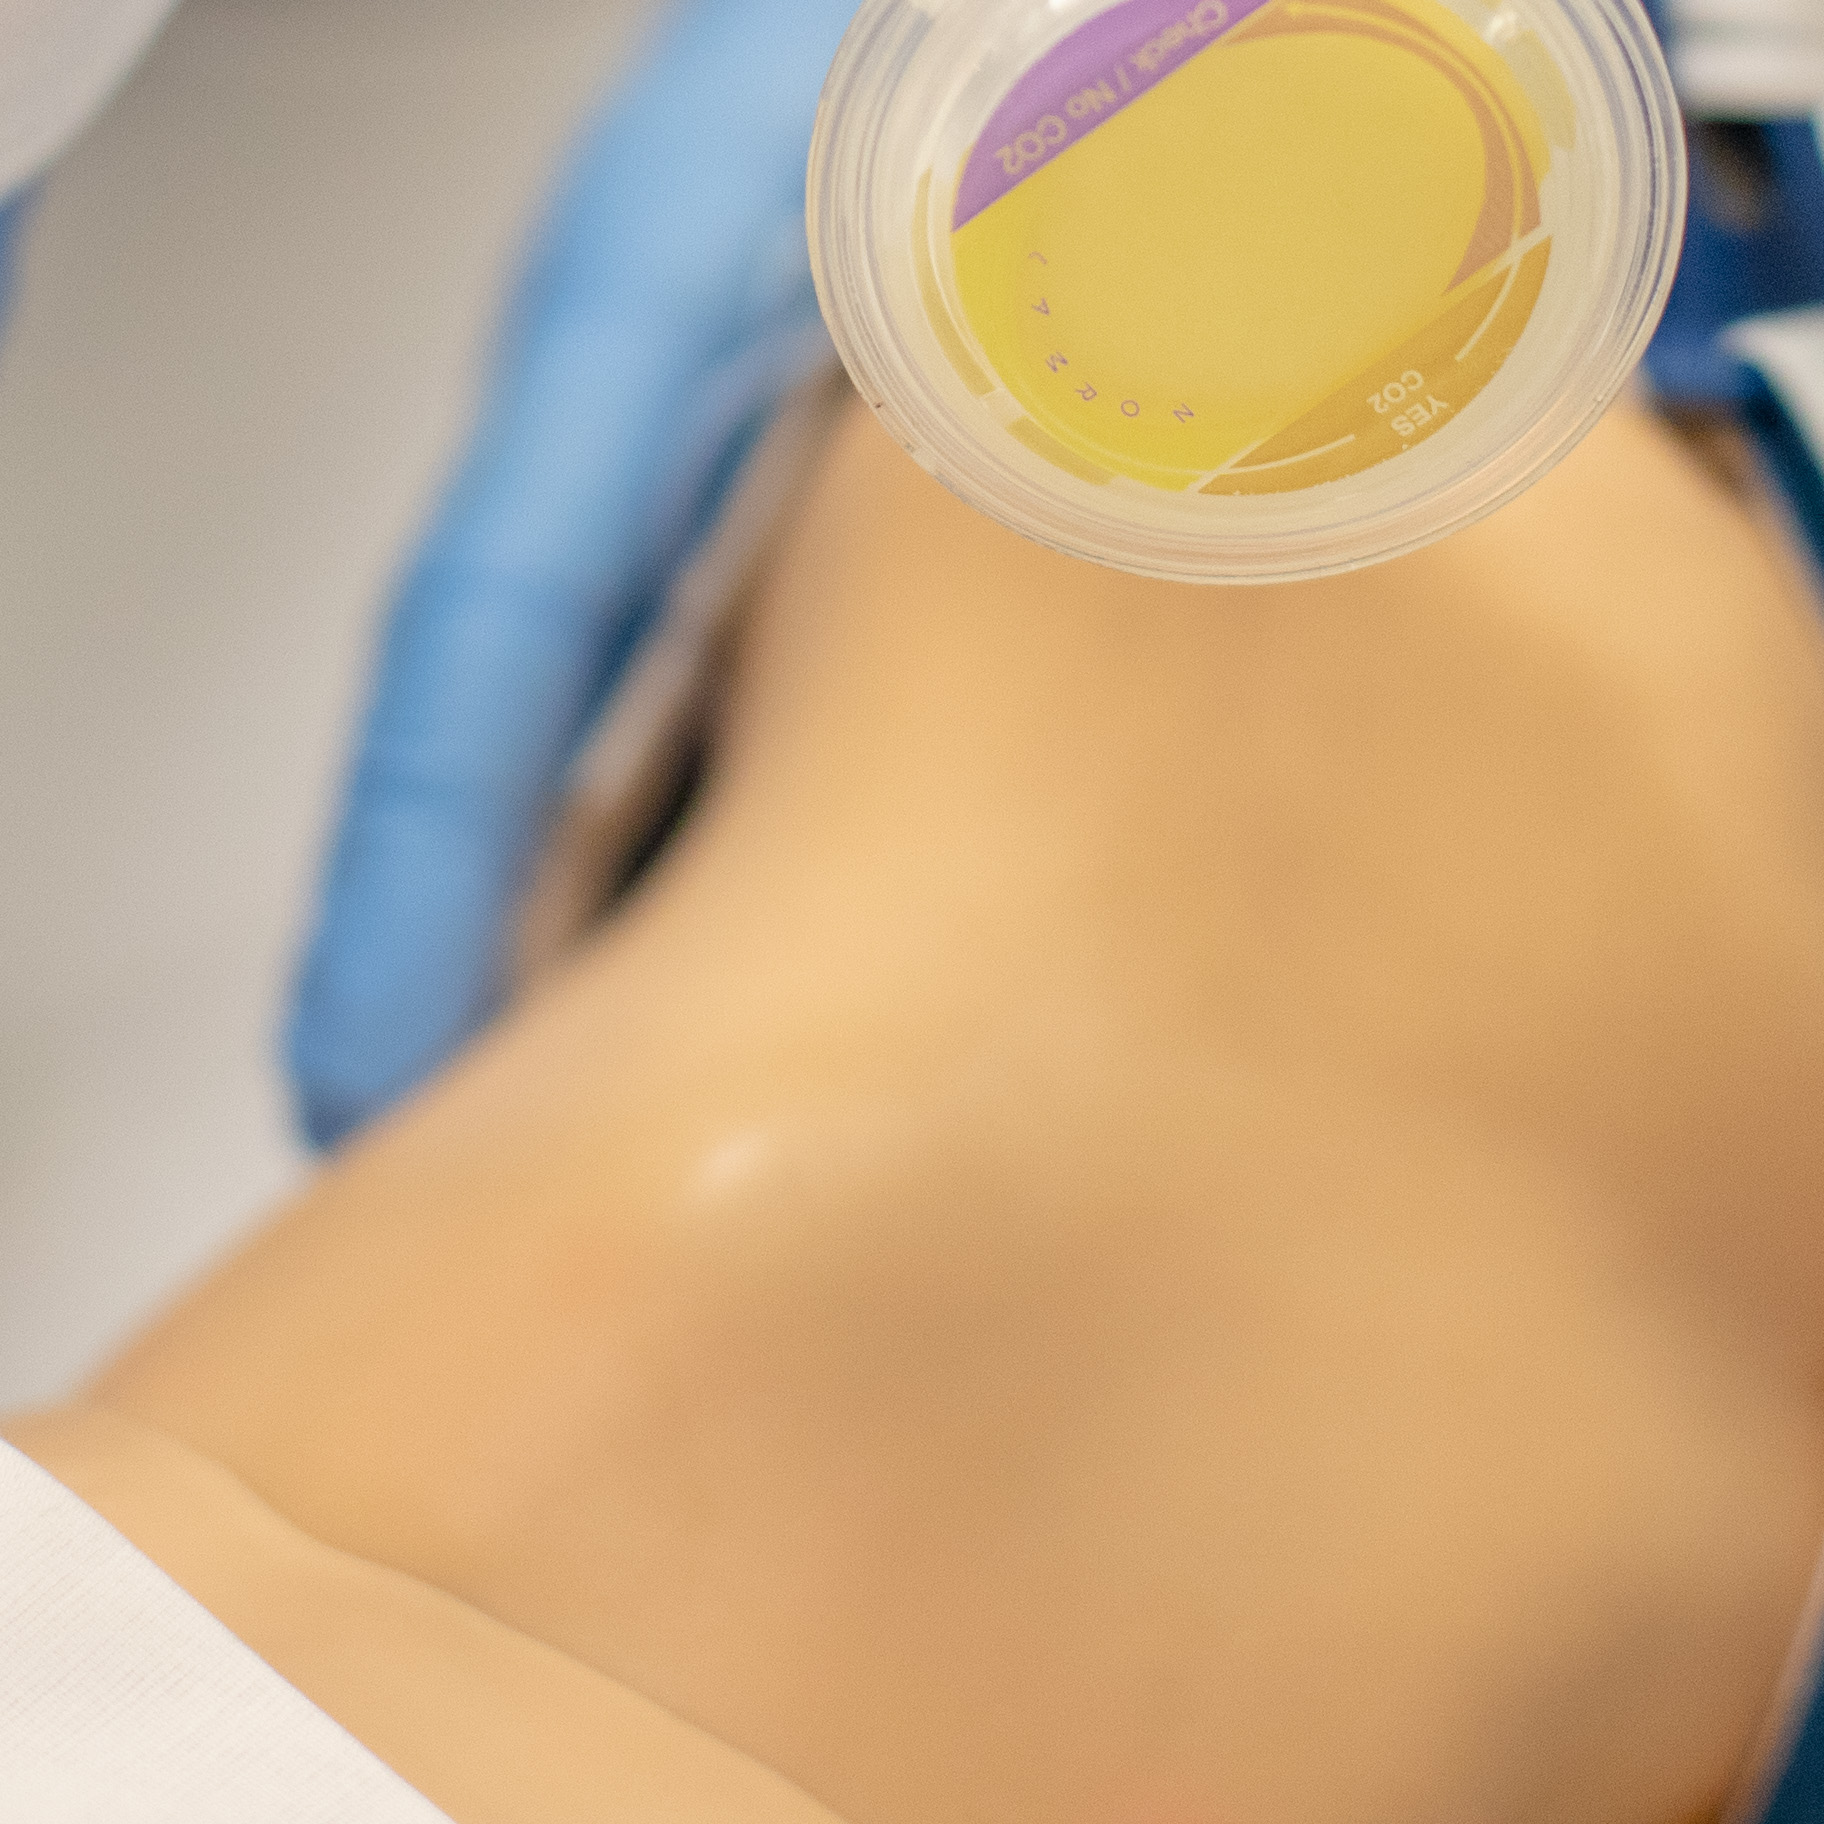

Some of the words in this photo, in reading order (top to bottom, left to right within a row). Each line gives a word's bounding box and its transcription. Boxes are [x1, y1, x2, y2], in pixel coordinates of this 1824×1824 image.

[1065, 79, 1117, 119] No
[1115, 64, 1132, 93] /
[995, 114, 1066, 176] CO2
[1028, 251, 1194, 424] NORMAL
[1367, 369, 1424, 414] CO2
[1391, 394, 1449, 436] YES
